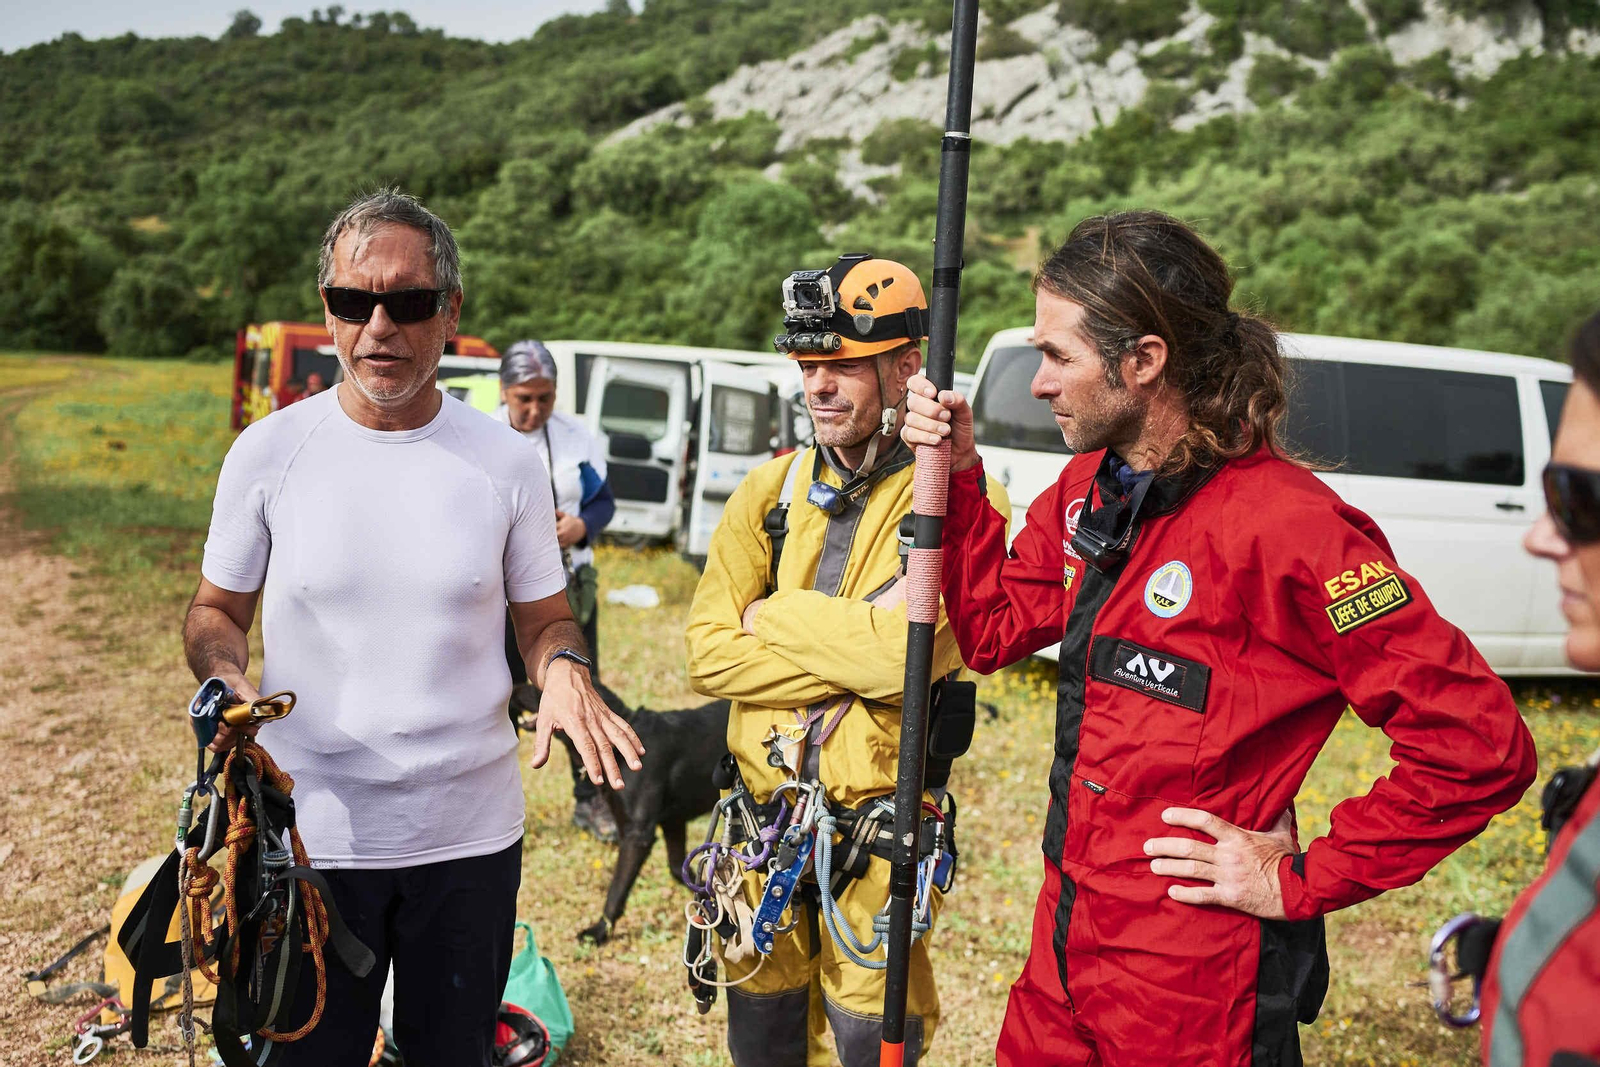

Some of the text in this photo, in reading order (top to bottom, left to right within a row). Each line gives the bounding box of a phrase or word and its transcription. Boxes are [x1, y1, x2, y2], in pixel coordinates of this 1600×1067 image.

[1323, 560, 1394, 600] ESAK
[1334, 581, 1401, 626] JEFE DE EQUIPO
[1114, 667, 1180, 697] Aventure Verticale
